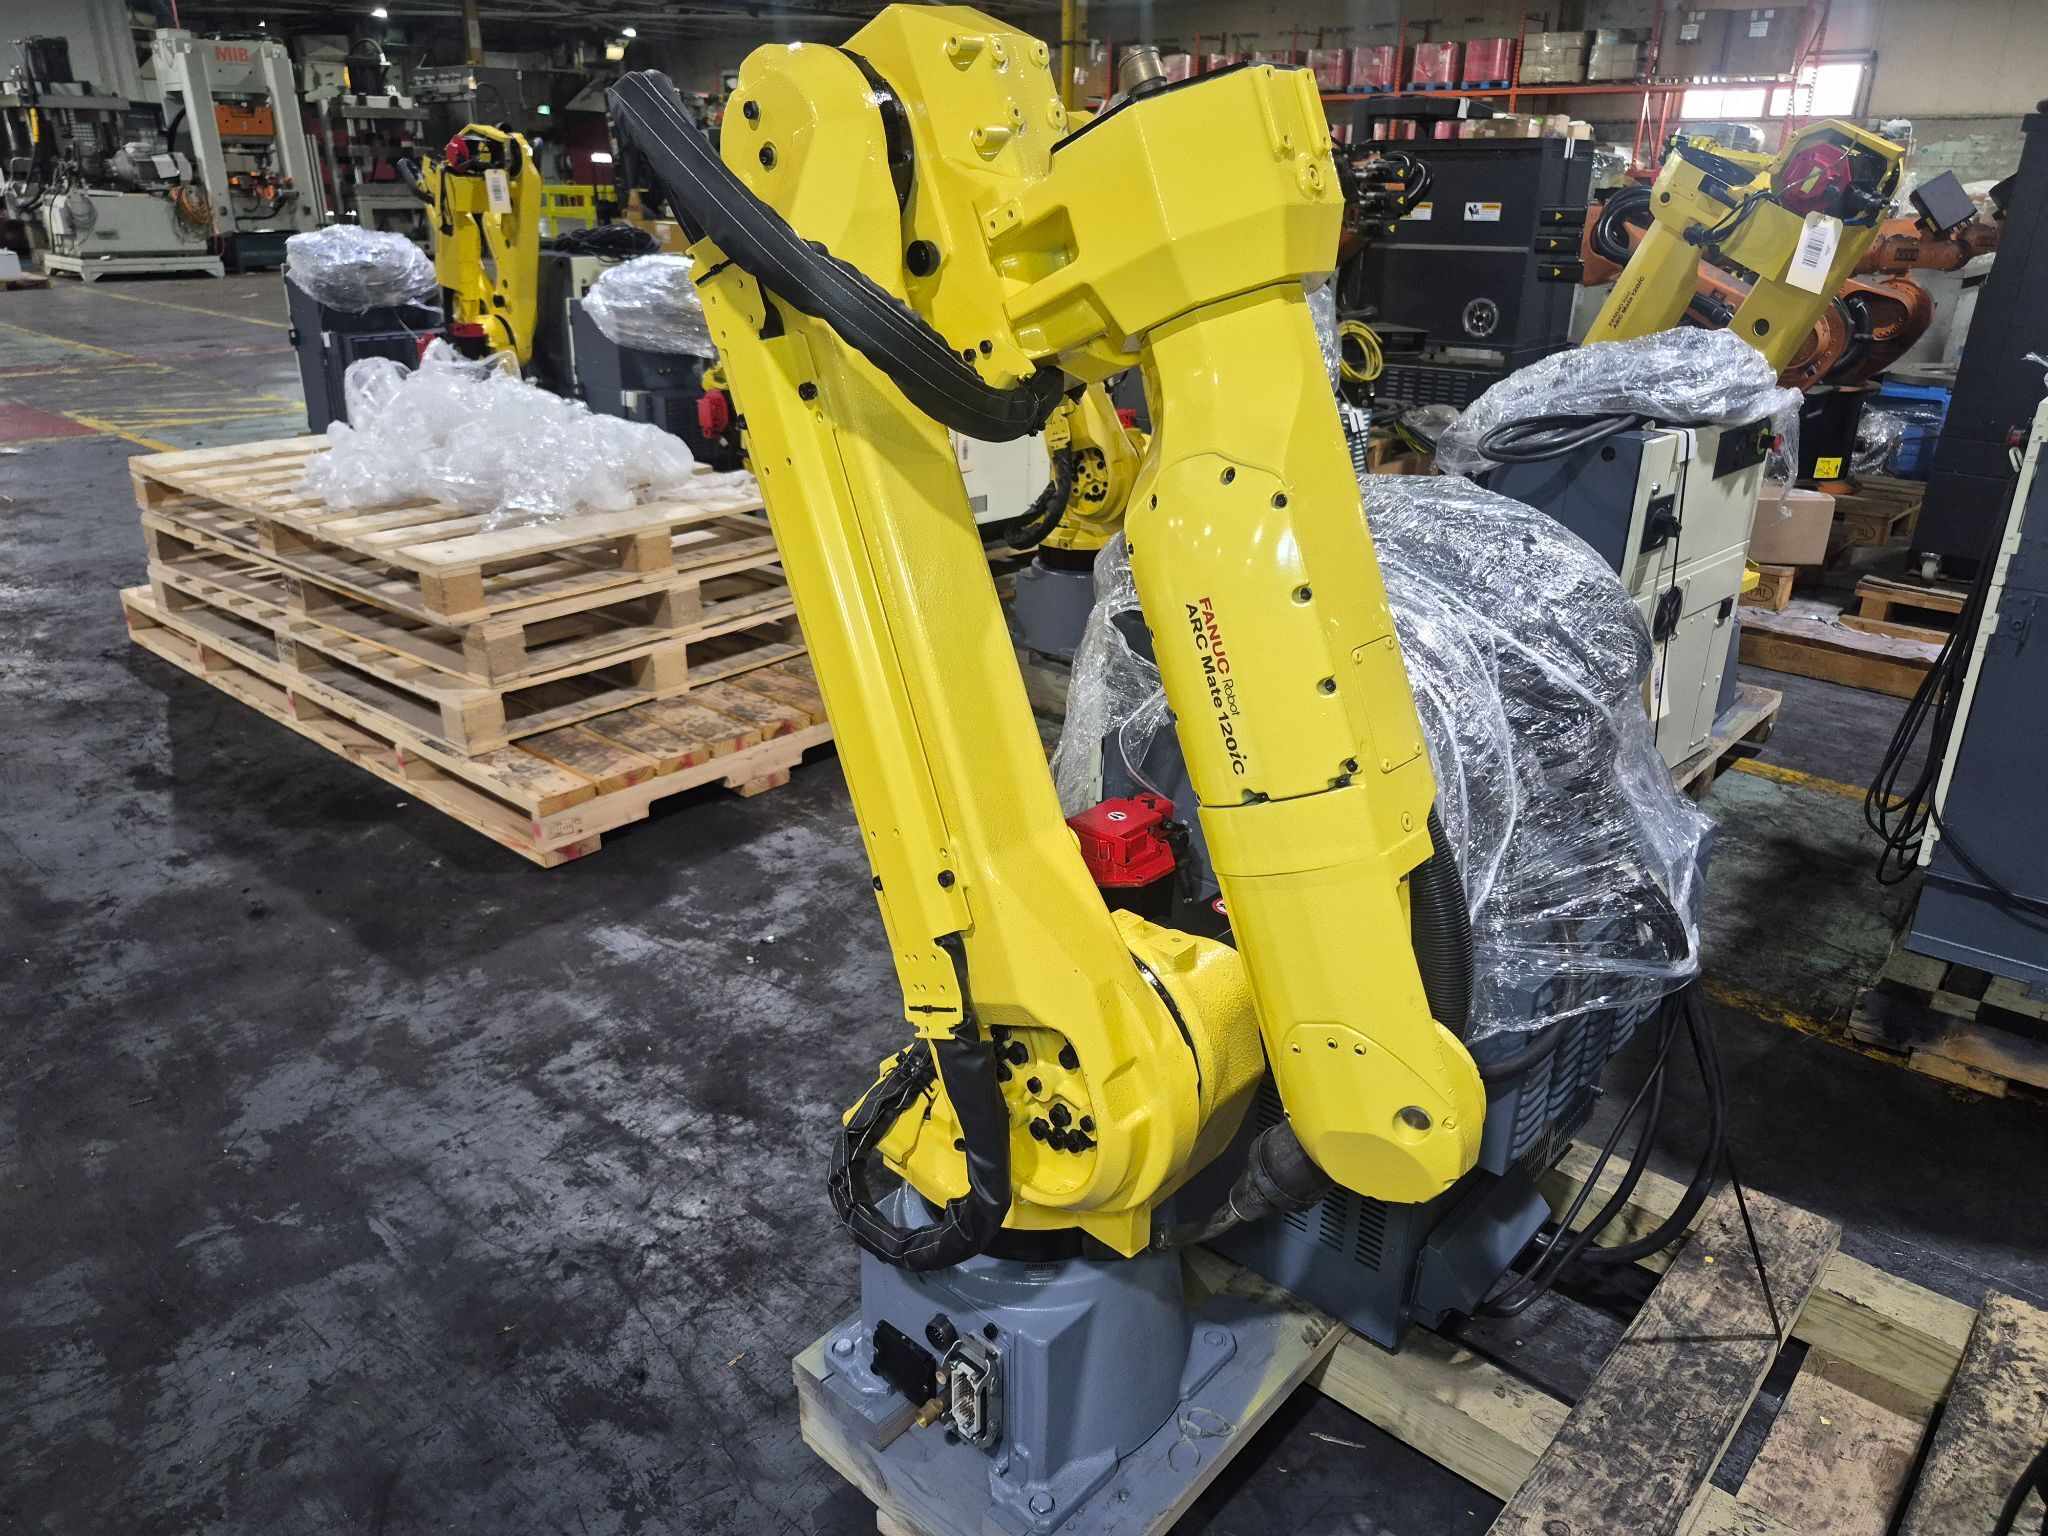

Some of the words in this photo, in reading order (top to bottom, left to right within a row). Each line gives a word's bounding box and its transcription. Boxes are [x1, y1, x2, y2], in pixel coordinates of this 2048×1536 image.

[1186, 604, 1208, 650] ARC
[1201, 655, 1223, 708] Mate
[1218, 711, 1247, 775] 120iC
[1199, 597, 1230, 675] FANUC
[1222, 678, 1240, 717] Robot
